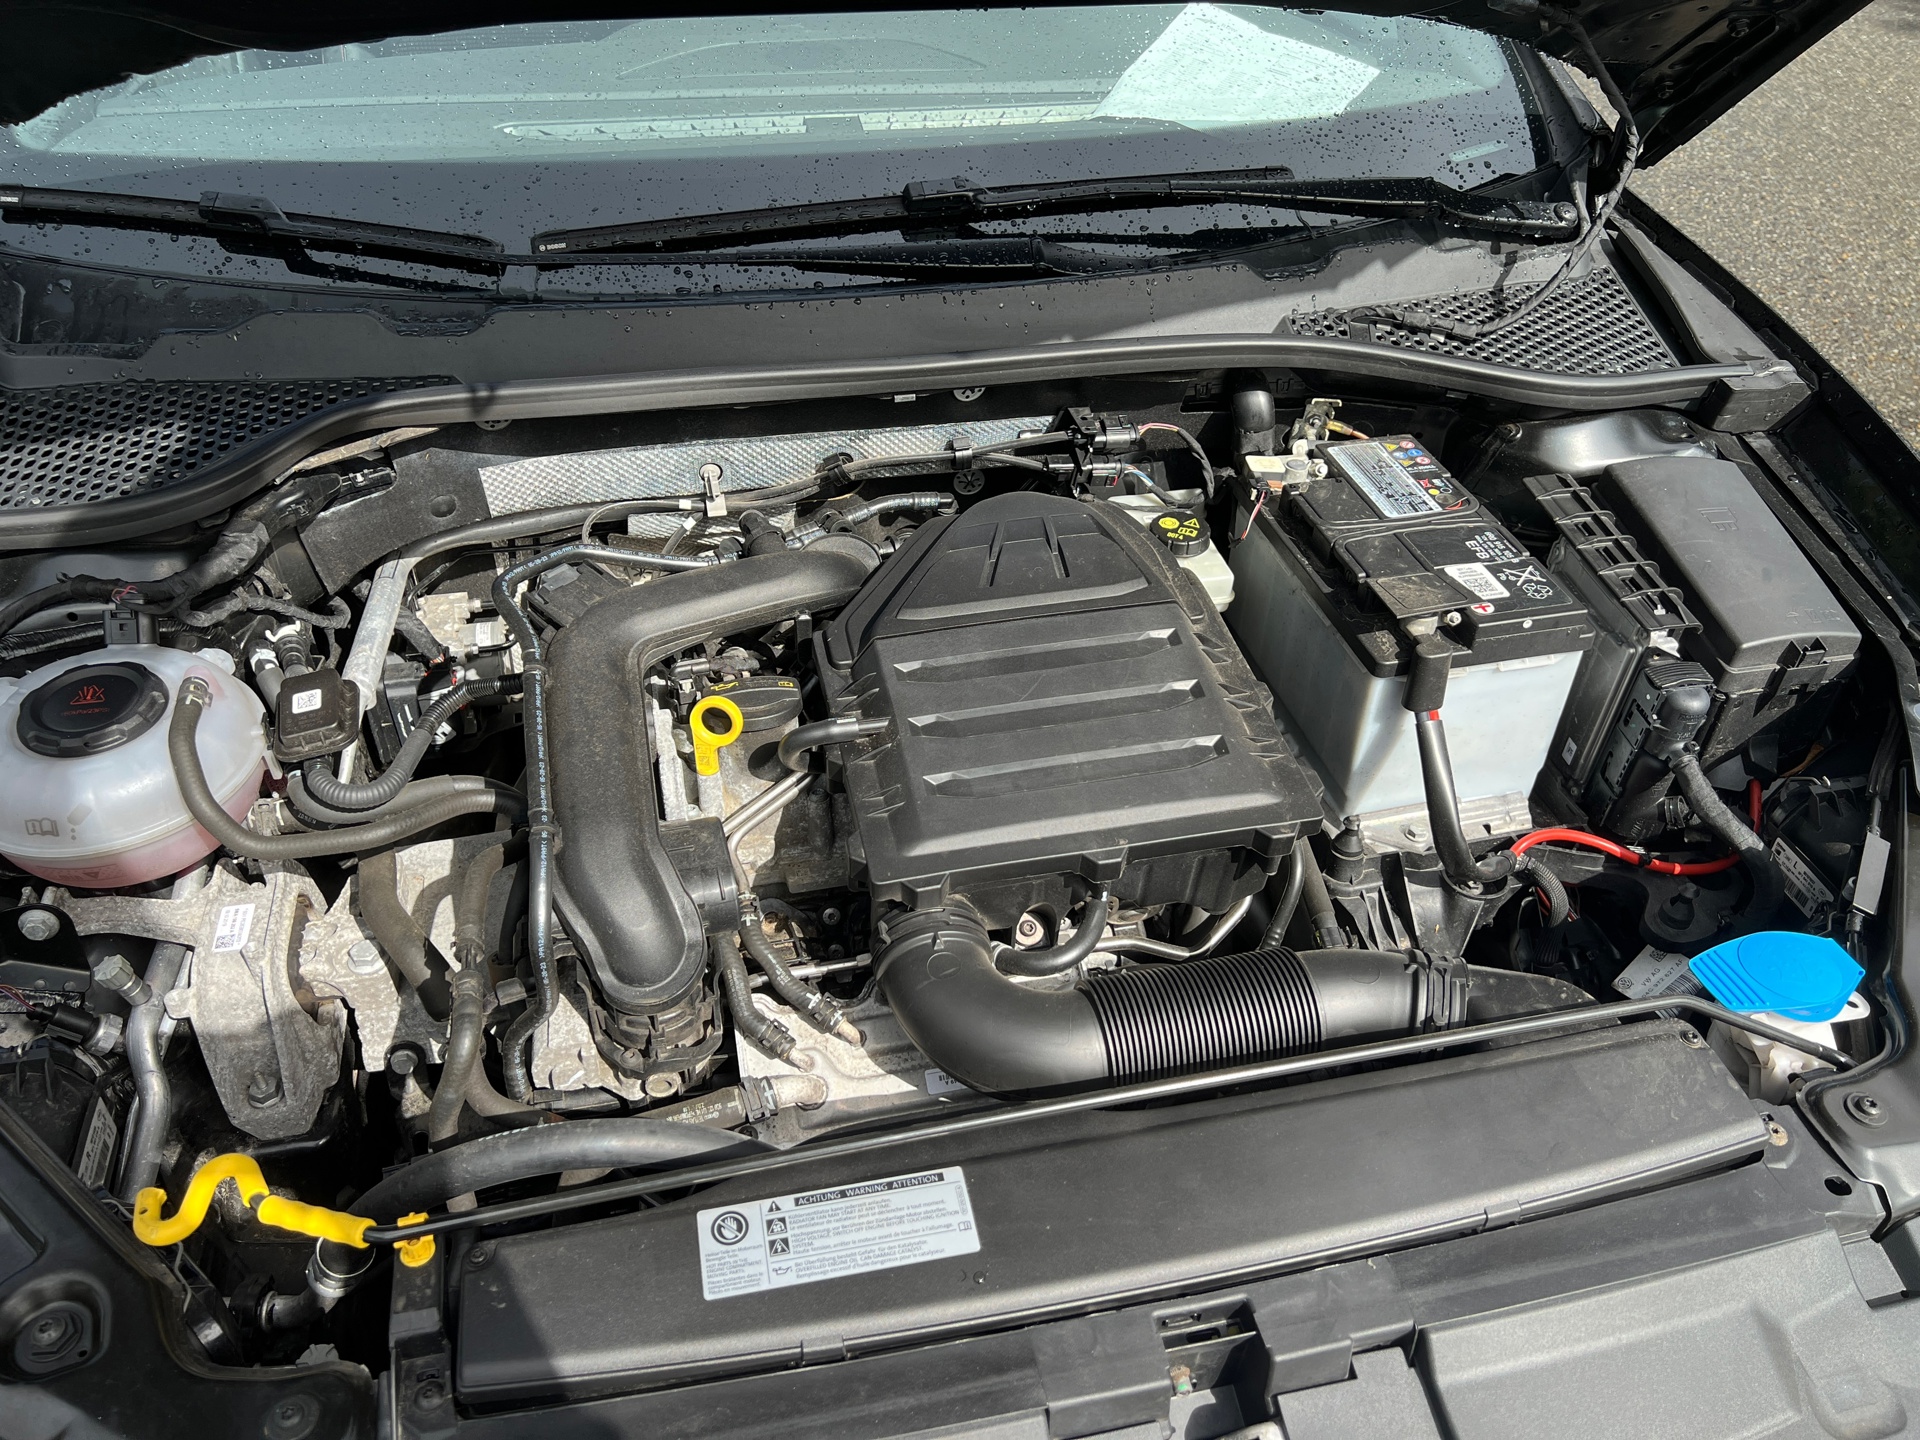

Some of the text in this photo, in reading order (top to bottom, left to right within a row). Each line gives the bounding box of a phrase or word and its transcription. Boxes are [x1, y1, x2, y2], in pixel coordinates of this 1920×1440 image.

[1465, 540, 1490, 559] EFB
[1641, 967, 1661, 986] VW AG
[798, 1174, 939, 1205] ACHTUNG WARNING ATTENTION
[789, 1216, 815, 1225] RADIATOR
[833, 1215, 857, 1223] radiateur
[865, 1223, 885, 1231] ENGINE
[886, 1219, 905, 1227] BEFORE
[907, 1214, 934, 1223] TOUCHING
[936, 1210, 959, 1218] IGNITION
[901, 1228, 921, 1236] toucher
[796, 1263, 827, 1273] OVERFILLED
[828, 1259, 848, 1267] ENGINE
[873, 1251, 896, 1259] DAMAGE
